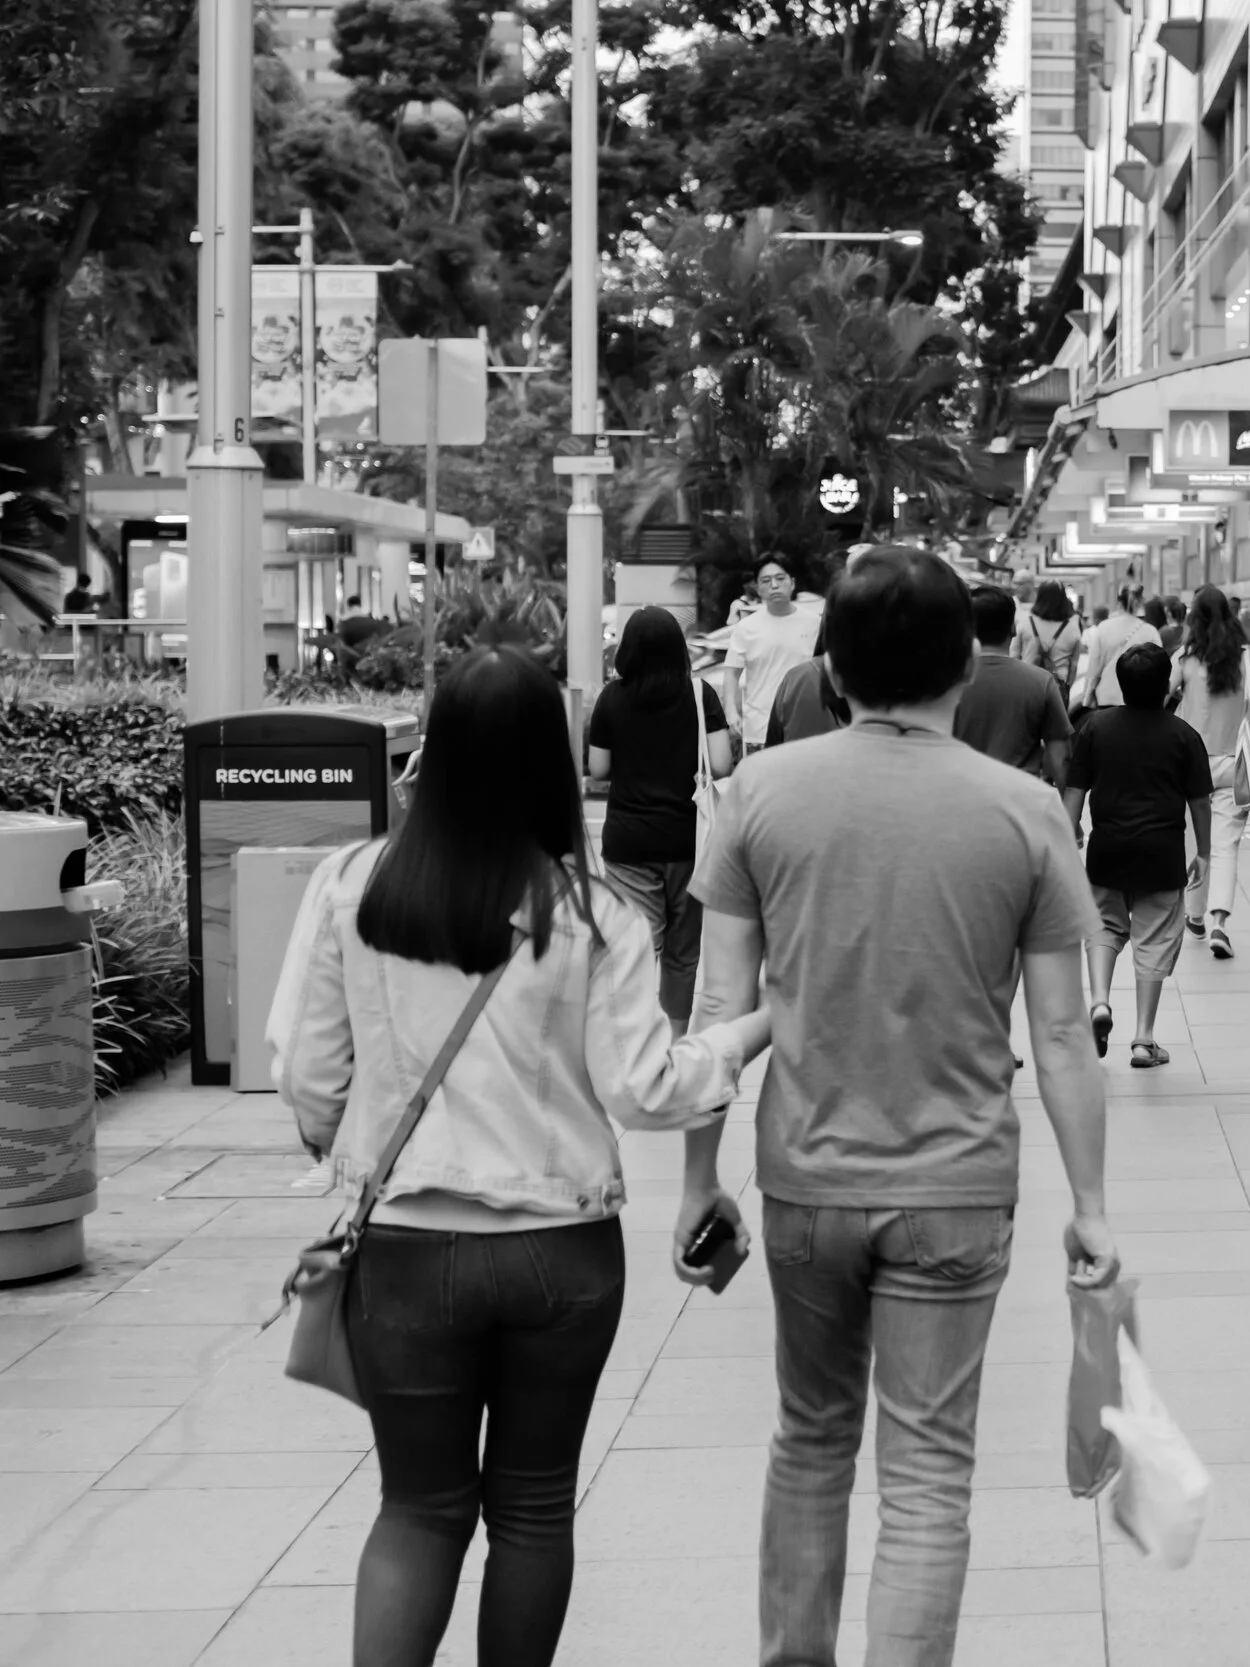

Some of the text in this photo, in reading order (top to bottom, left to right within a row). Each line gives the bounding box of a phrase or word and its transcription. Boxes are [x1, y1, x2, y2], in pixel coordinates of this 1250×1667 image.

[234, 417, 245, 443] 6
[215, 768, 354, 784] RECYCLING BIN
